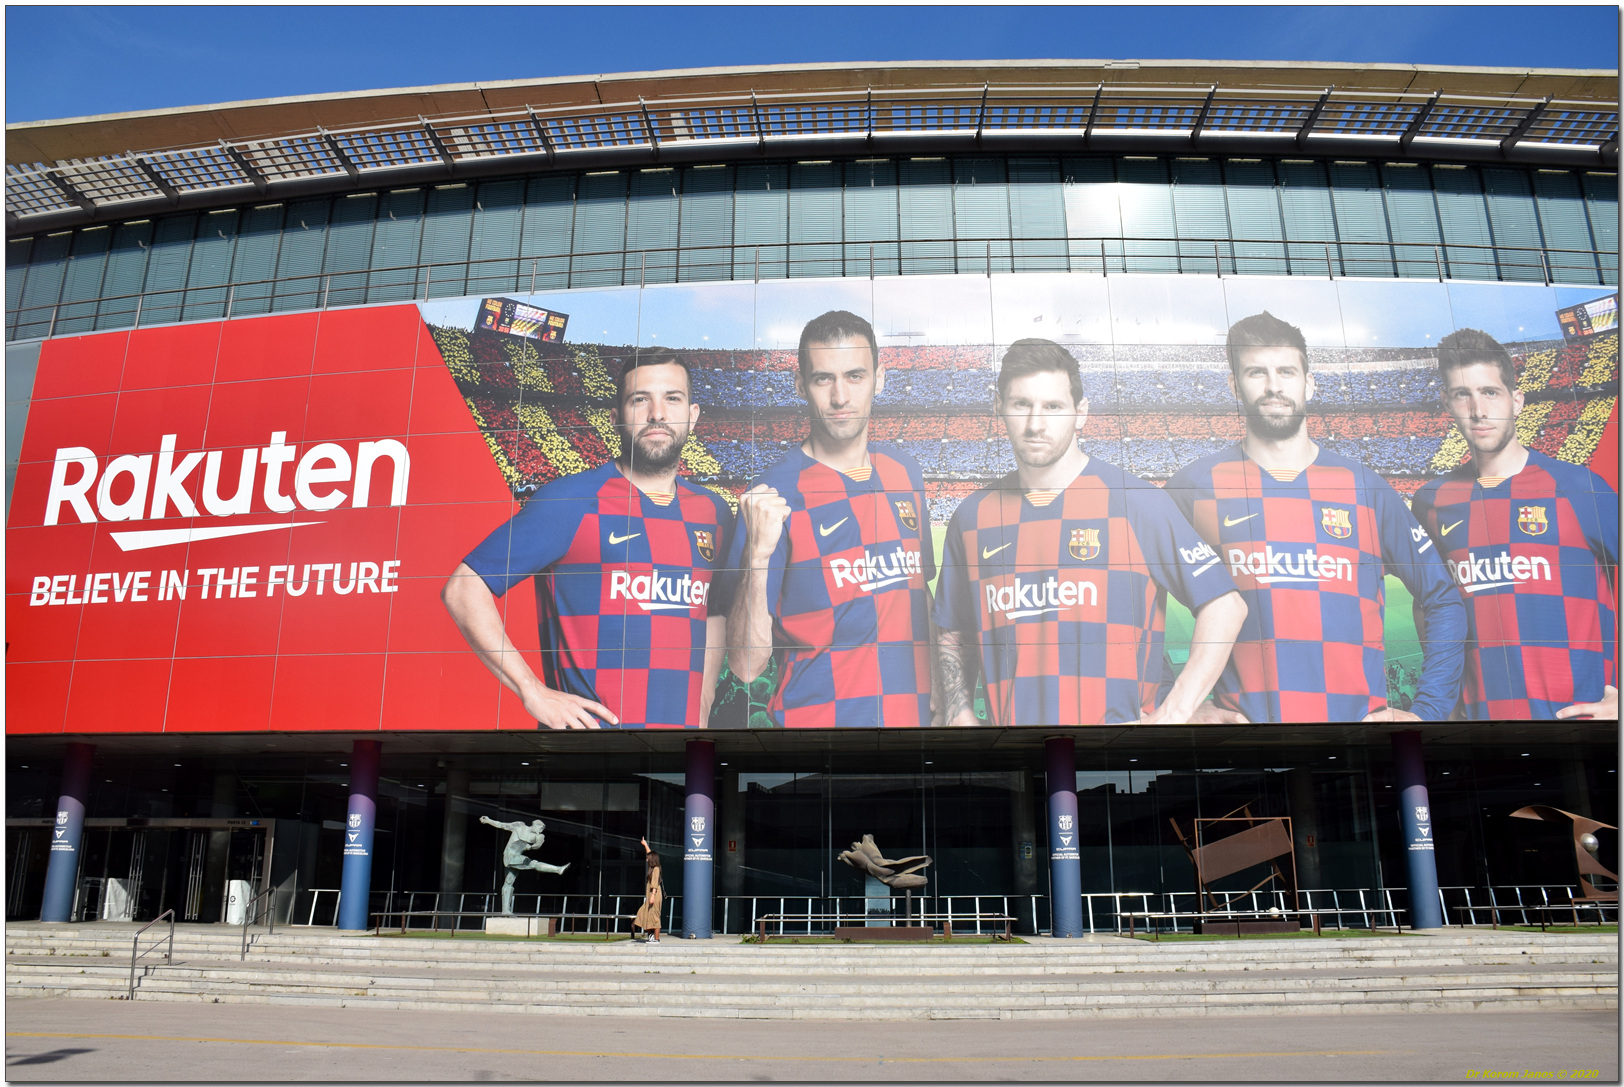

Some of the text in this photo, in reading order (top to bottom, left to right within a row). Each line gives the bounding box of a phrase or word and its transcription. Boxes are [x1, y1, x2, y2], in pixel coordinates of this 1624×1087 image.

[43, 431, 411, 526] Rakuten
[1228, 545, 1353, 582] Rakuten
[1446, 551, 1552, 586] Rakuten
[29, 560, 401, 606] BELIEVE IN THE FUTURE
[986, 576, 1098, 614] Rakuten
